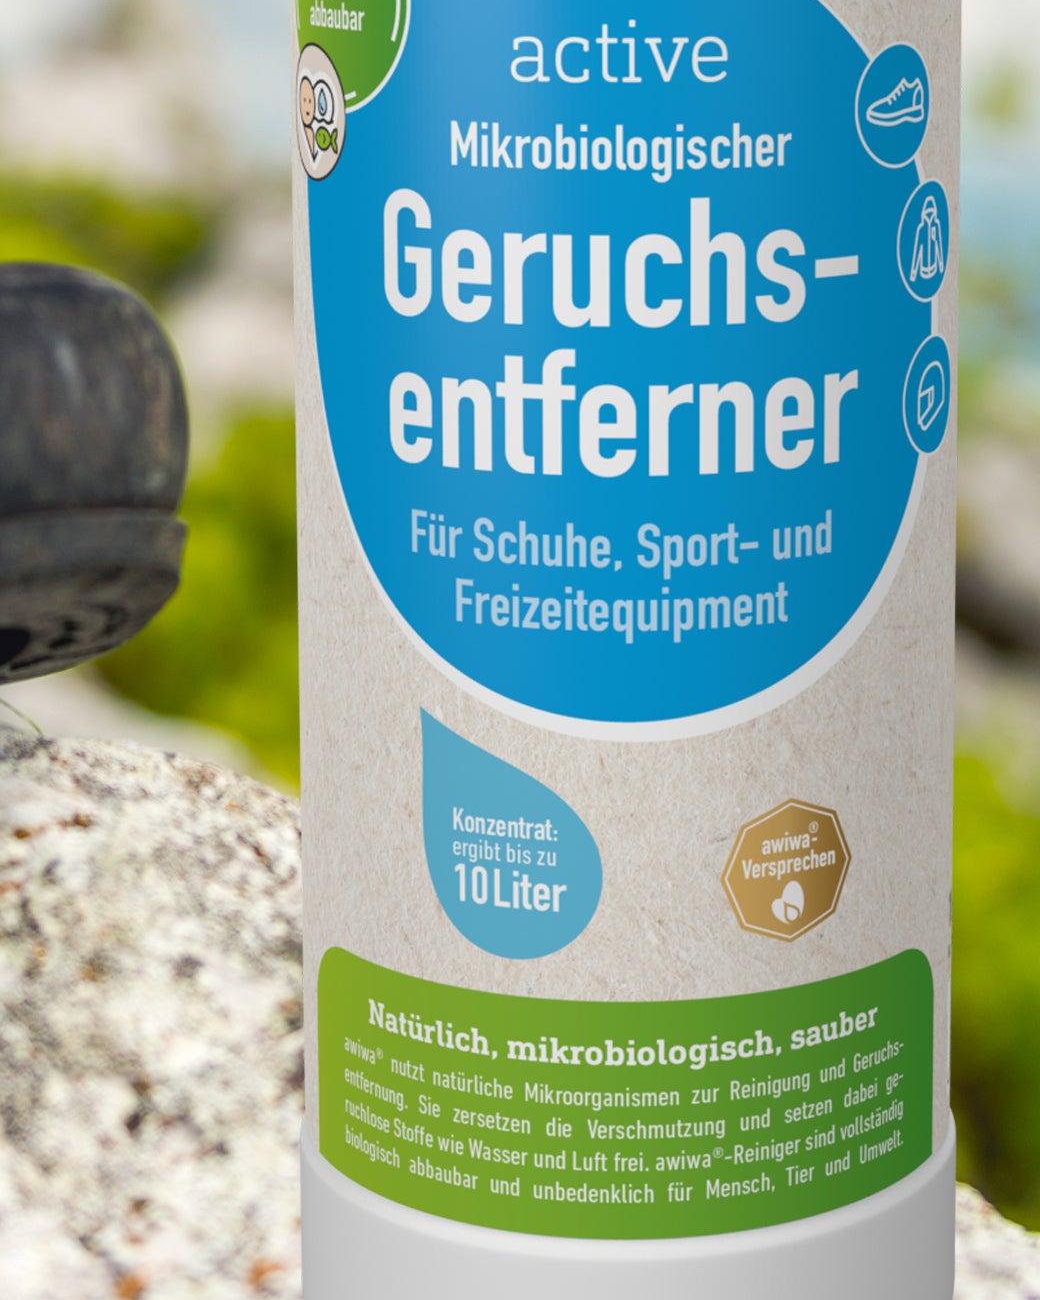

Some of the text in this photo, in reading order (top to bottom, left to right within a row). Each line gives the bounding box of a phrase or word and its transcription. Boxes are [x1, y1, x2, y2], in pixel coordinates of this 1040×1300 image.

[309, 3, 365, 31] abbaubar
[510, 19, 729, 83] active
[450, 120, 792, 183] Mikrobiologischer
[383, 188, 860, 328] Geruchs-
[389, 348, 859, 478] entferner
[411, 508, 833, 580] Für Schuhe, Sport- und
[455, 577, 789, 644] Freizeitequipment
[452, 806, 559, 842] Konzentrat:
[452, 839, 557, 867] ergibt bis zu
[454, 863, 568, 913] 10 Liter
[742, 849, 836, 881] Versprechen
[368, 998, 879, 1070] Natürlich, mikrobiologisch, sauber
[344, 1067, 905, 1140] entfernung. Sie zersetzen die Verschmutzung und setzen dabei ge-
[391, 1058, 425, 1083] nutzt
[433, 1070, 513, 1100] natürliche
[524, 1082, 680, 1112] Mikroorganismen
[691, 1087, 720, 1105] zur
[730, 1072, 810, 1099] Reinigung
[819, 1058, 846, 1084] und
[853, 1040, 905, 1073] Geruchs-
[344, 1098, 390, 1133] ruchlose
[393, 1117, 434, 1148] Stoffe
[437, 1134, 465, 1156] wie
[468, 1138, 529, 1166] Wasser
[533, 1150, 566, 1171] und
[572, 1150, 608, 1172] Luft
[614, 1152, 650, 1173] frei.
[804, 1125, 836, 1151] sind
[840, 1099, 905, 1141] vollständig
[344, 1123, 905, 1204] biologisch abbaubar und unbedenklich für Mensch, Tier und Umwelt.
